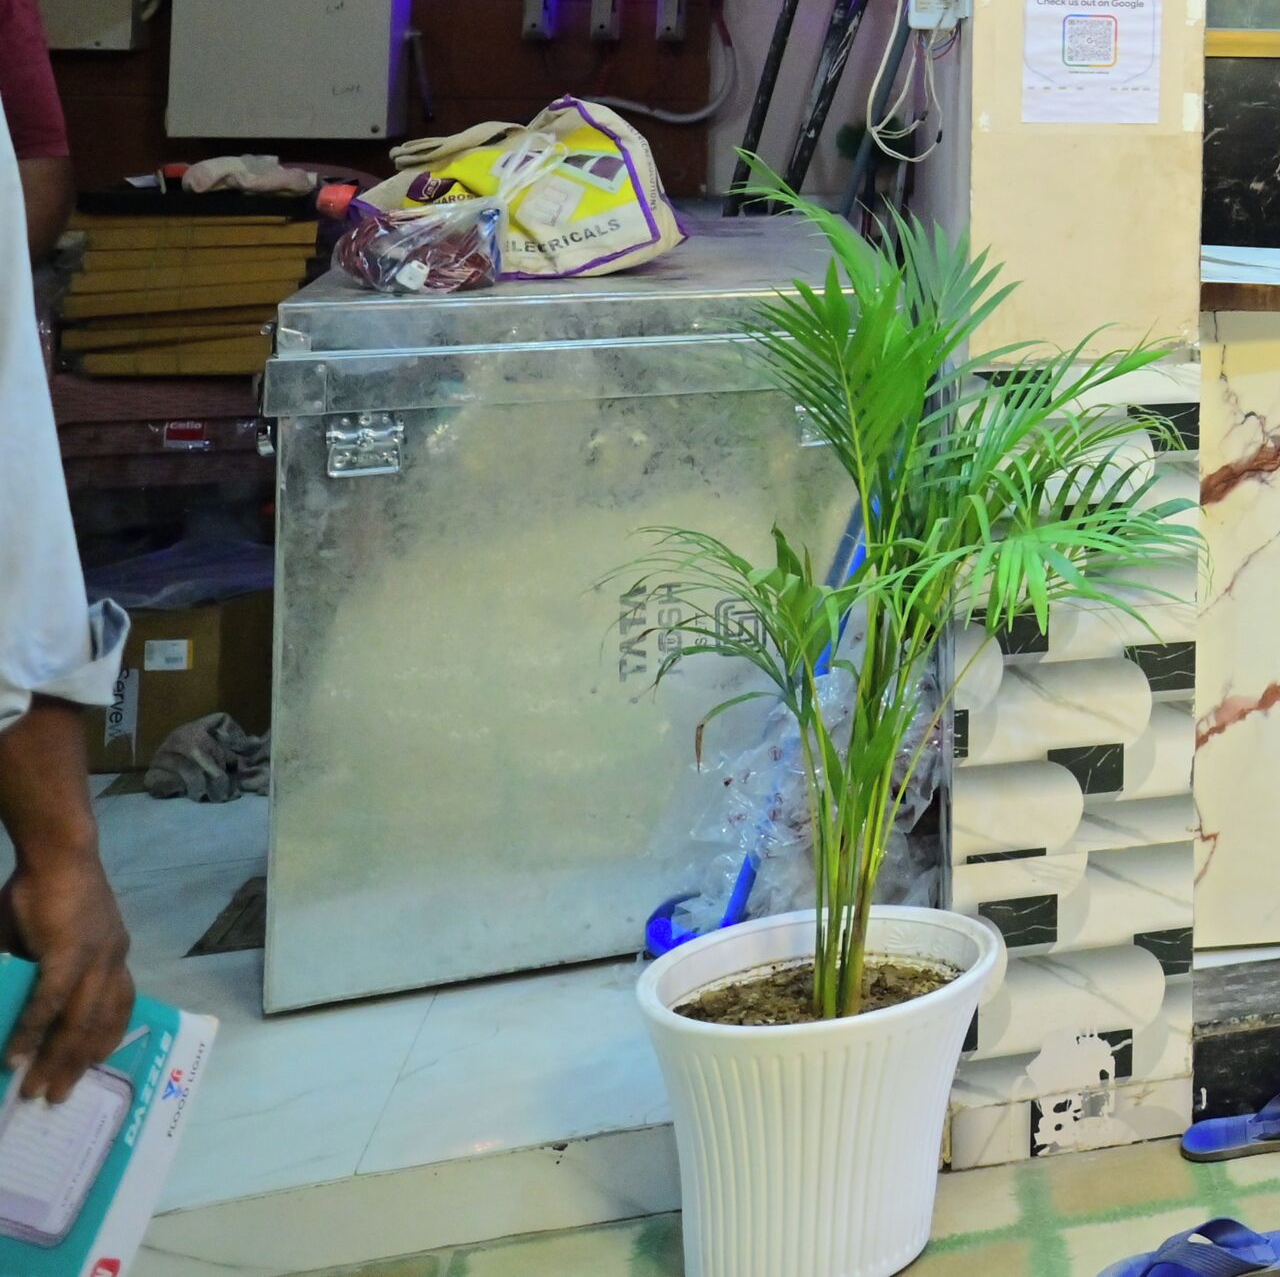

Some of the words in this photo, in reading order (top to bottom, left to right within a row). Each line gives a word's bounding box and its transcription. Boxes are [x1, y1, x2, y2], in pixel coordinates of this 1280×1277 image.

[1068, 0, 1080, 7] us
[618, 584, 648, 683] TATA
[124, 1033, 174, 1147] DAZZLE
[166, 1087, 190, 1138] FLOOD
[188, 1042, 206, 1083] LIGHT
